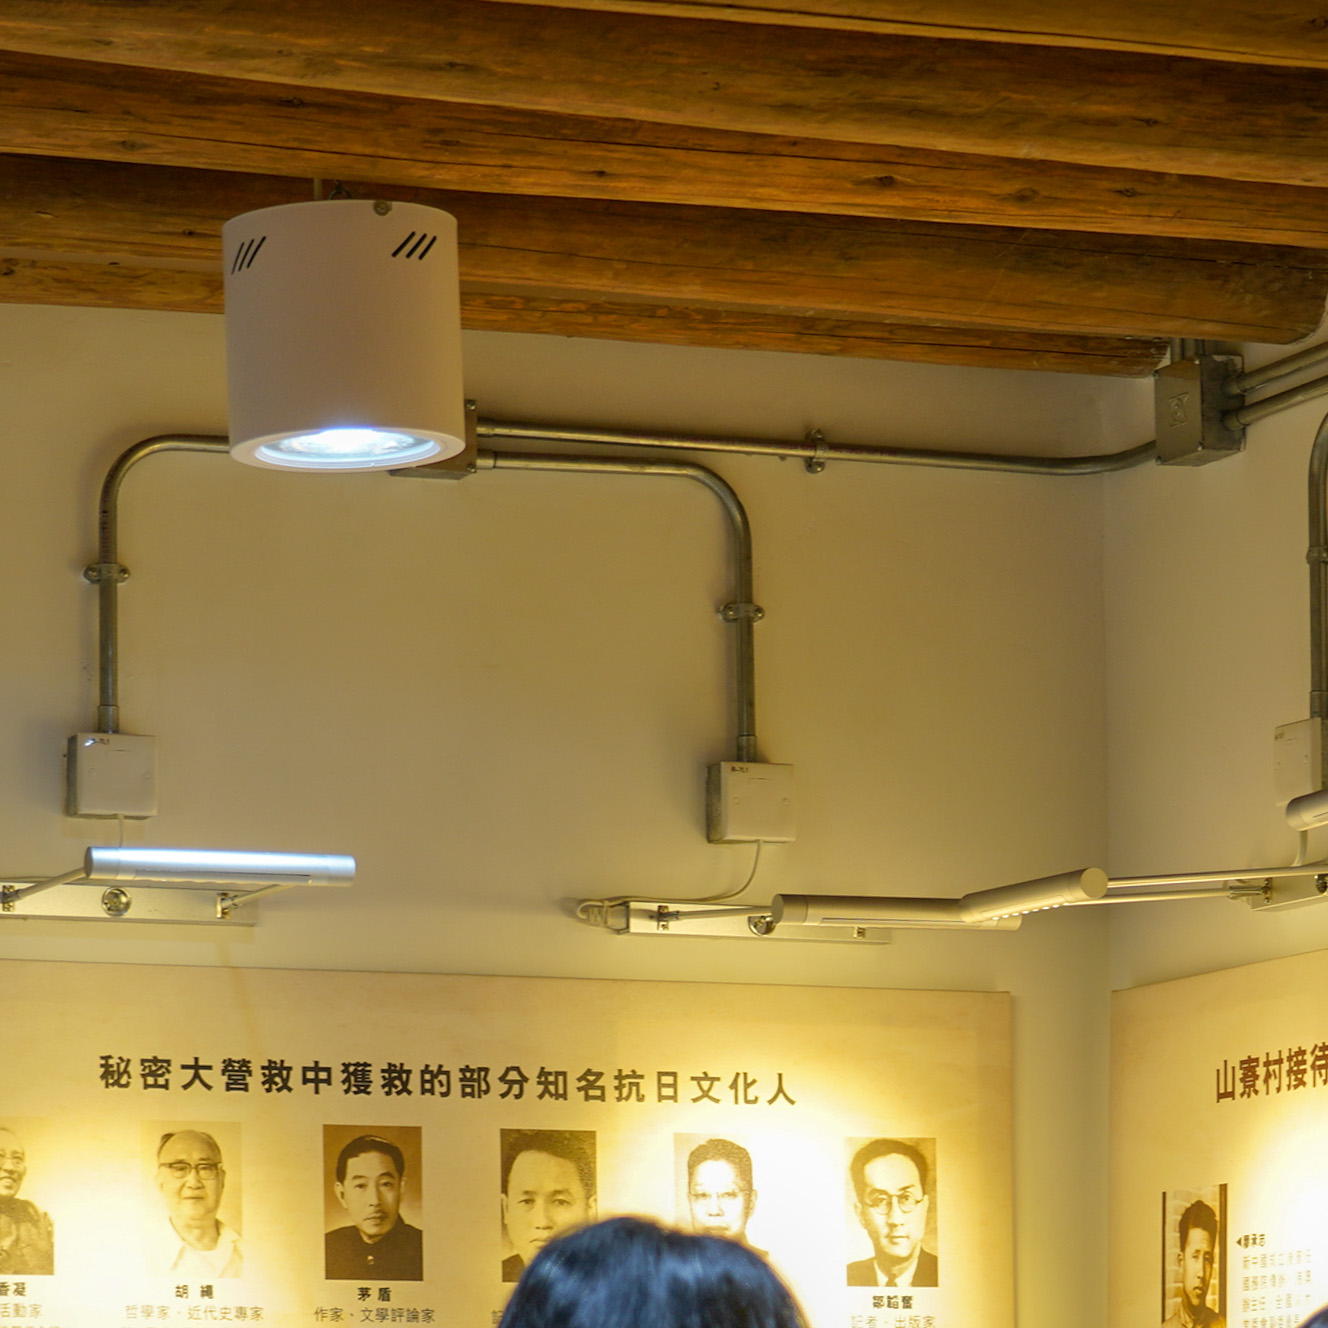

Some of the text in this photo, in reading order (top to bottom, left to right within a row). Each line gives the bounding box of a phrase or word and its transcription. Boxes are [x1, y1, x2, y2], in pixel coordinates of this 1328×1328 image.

[99, 1054, 797, 1107] 秘密大營救中獲救的部分知名抗日文化人
[313, 1307, 436, 1324] 作家、文學評論家
